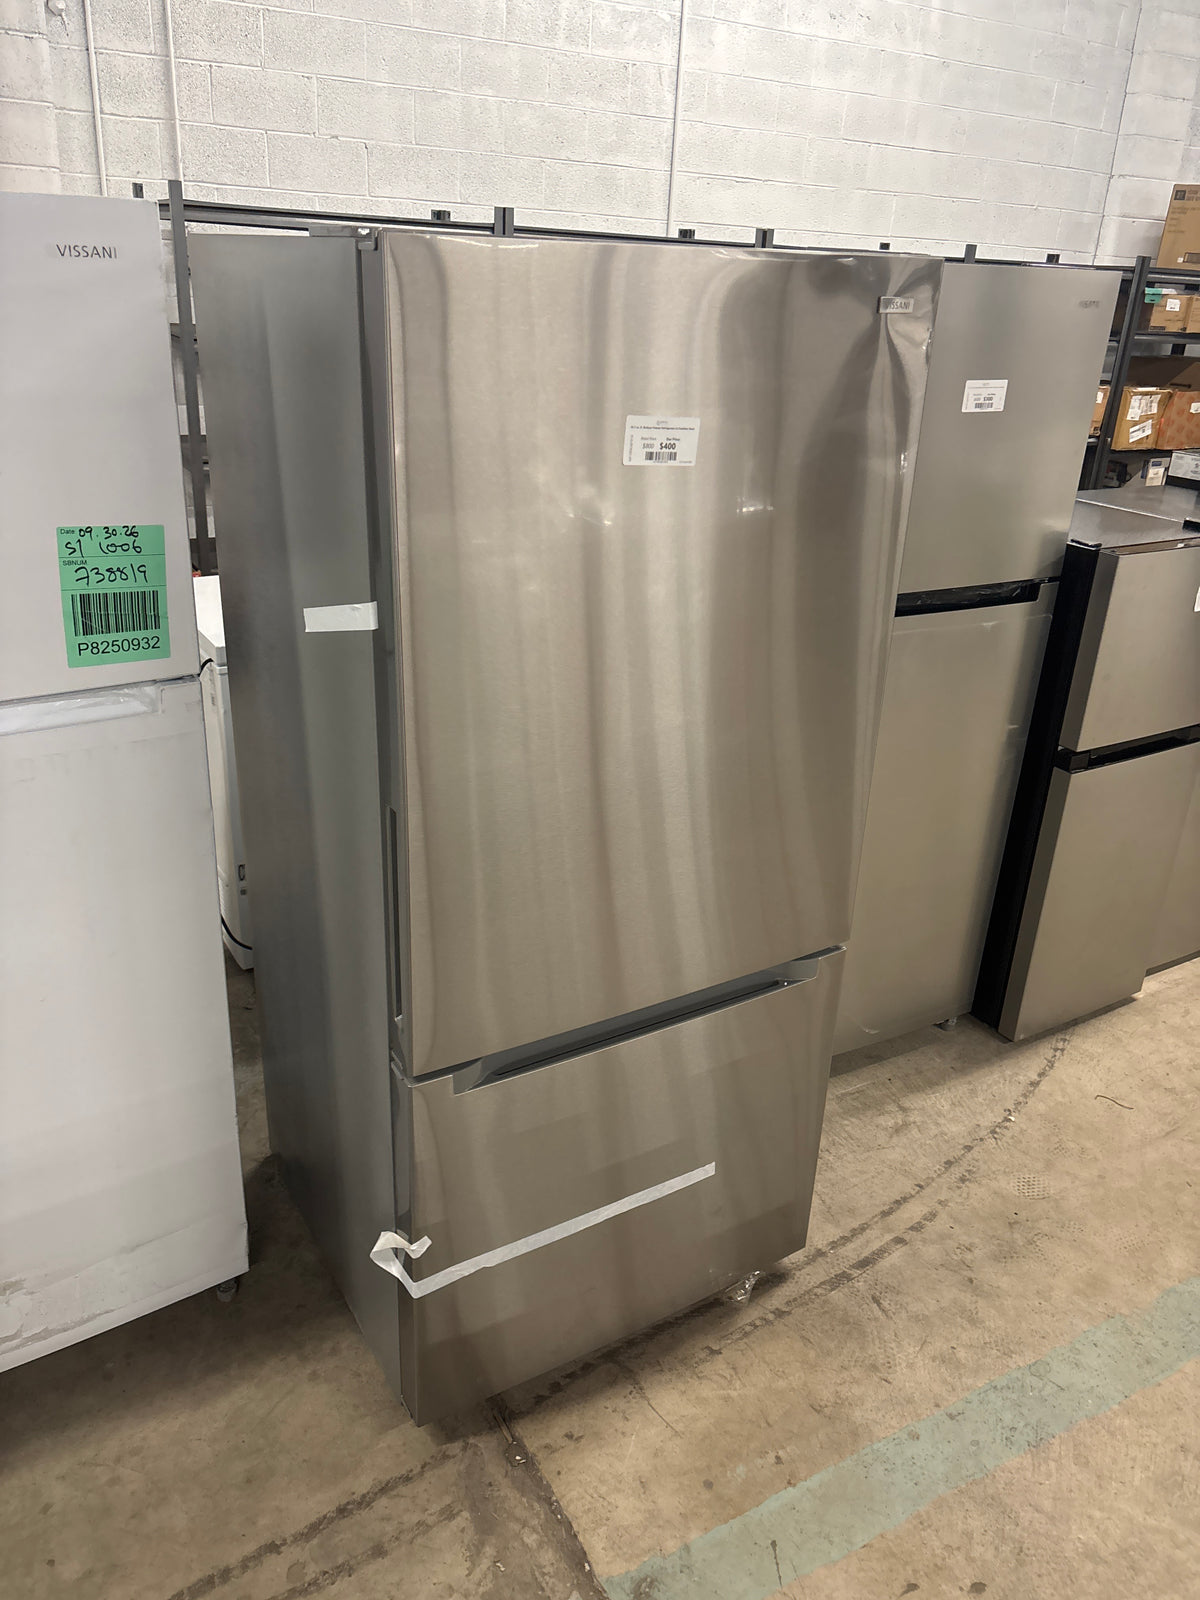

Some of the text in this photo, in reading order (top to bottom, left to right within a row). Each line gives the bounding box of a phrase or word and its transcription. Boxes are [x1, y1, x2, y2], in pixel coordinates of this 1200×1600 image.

[56, 244, 117, 259] VISSANI
[659, 442, 677, 450] $400
[78, 635, 161, 657] P8250932
